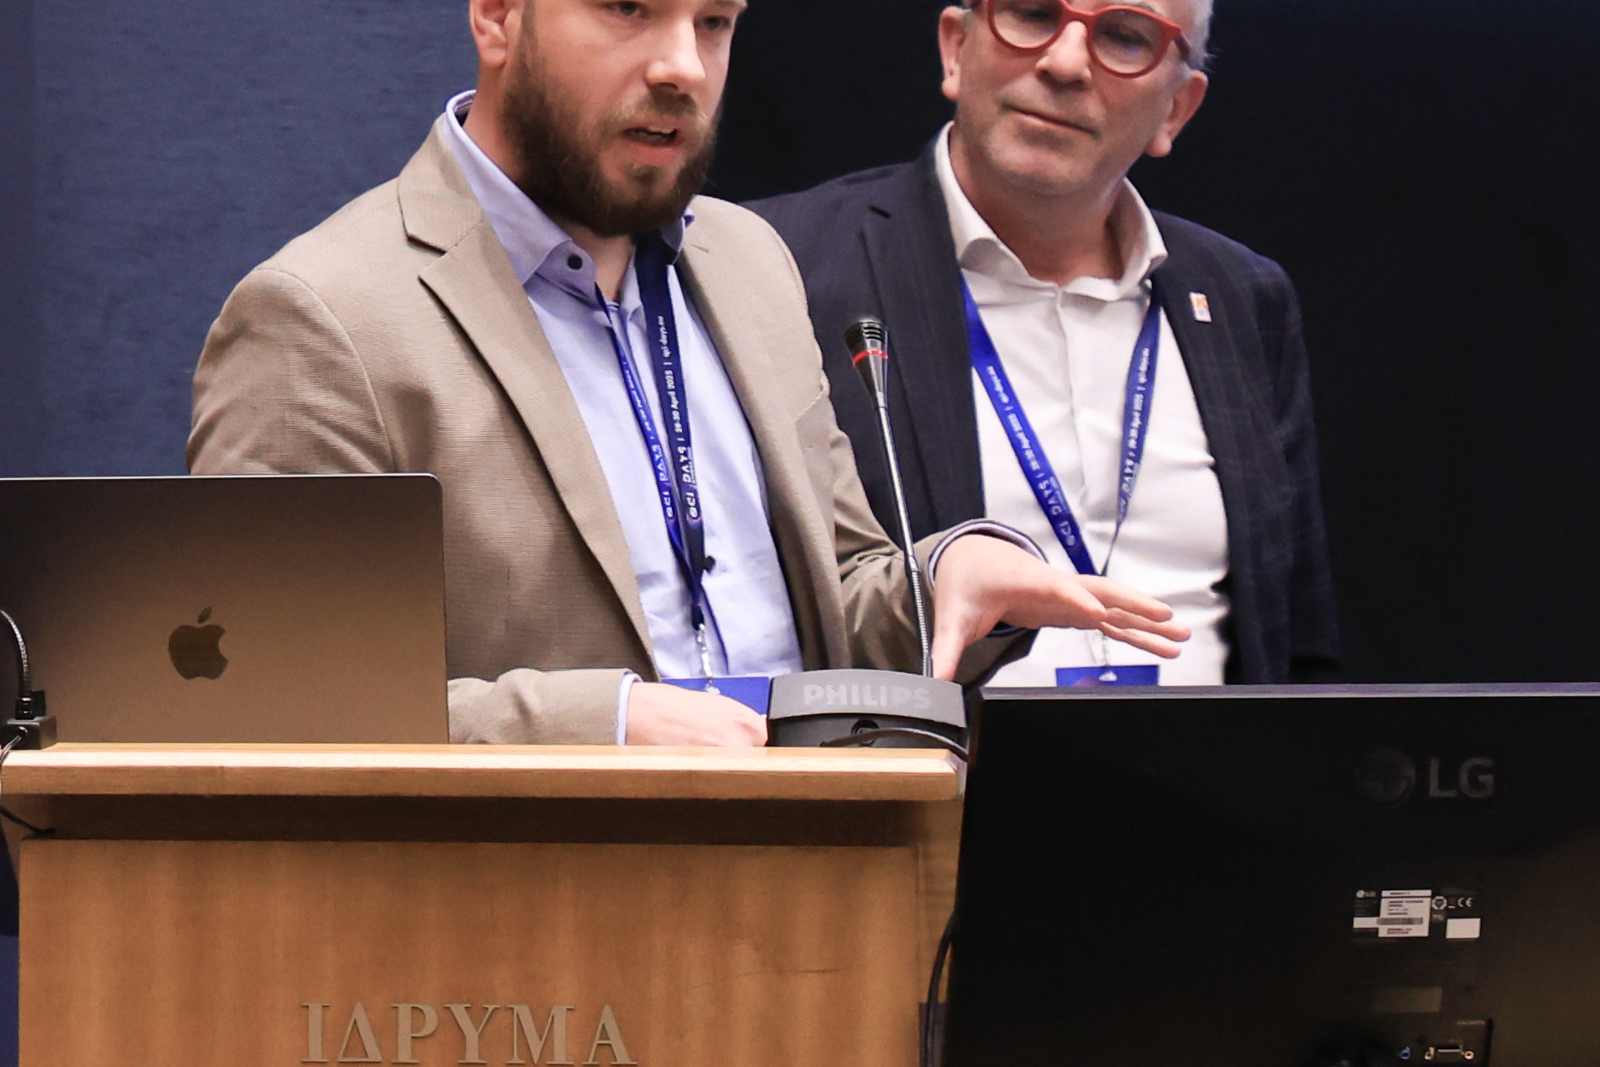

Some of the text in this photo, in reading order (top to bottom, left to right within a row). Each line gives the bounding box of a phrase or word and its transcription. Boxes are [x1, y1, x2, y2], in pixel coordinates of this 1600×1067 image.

[667, 391, 680, 410] April
[677, 446, 692, 483] DAYS
[803, 684, 932, 710] PHILIPS
[1429, 757, 1494, 797] LG
[301, 1000, 638, 1066] ΙΔΡΥΜΑ
